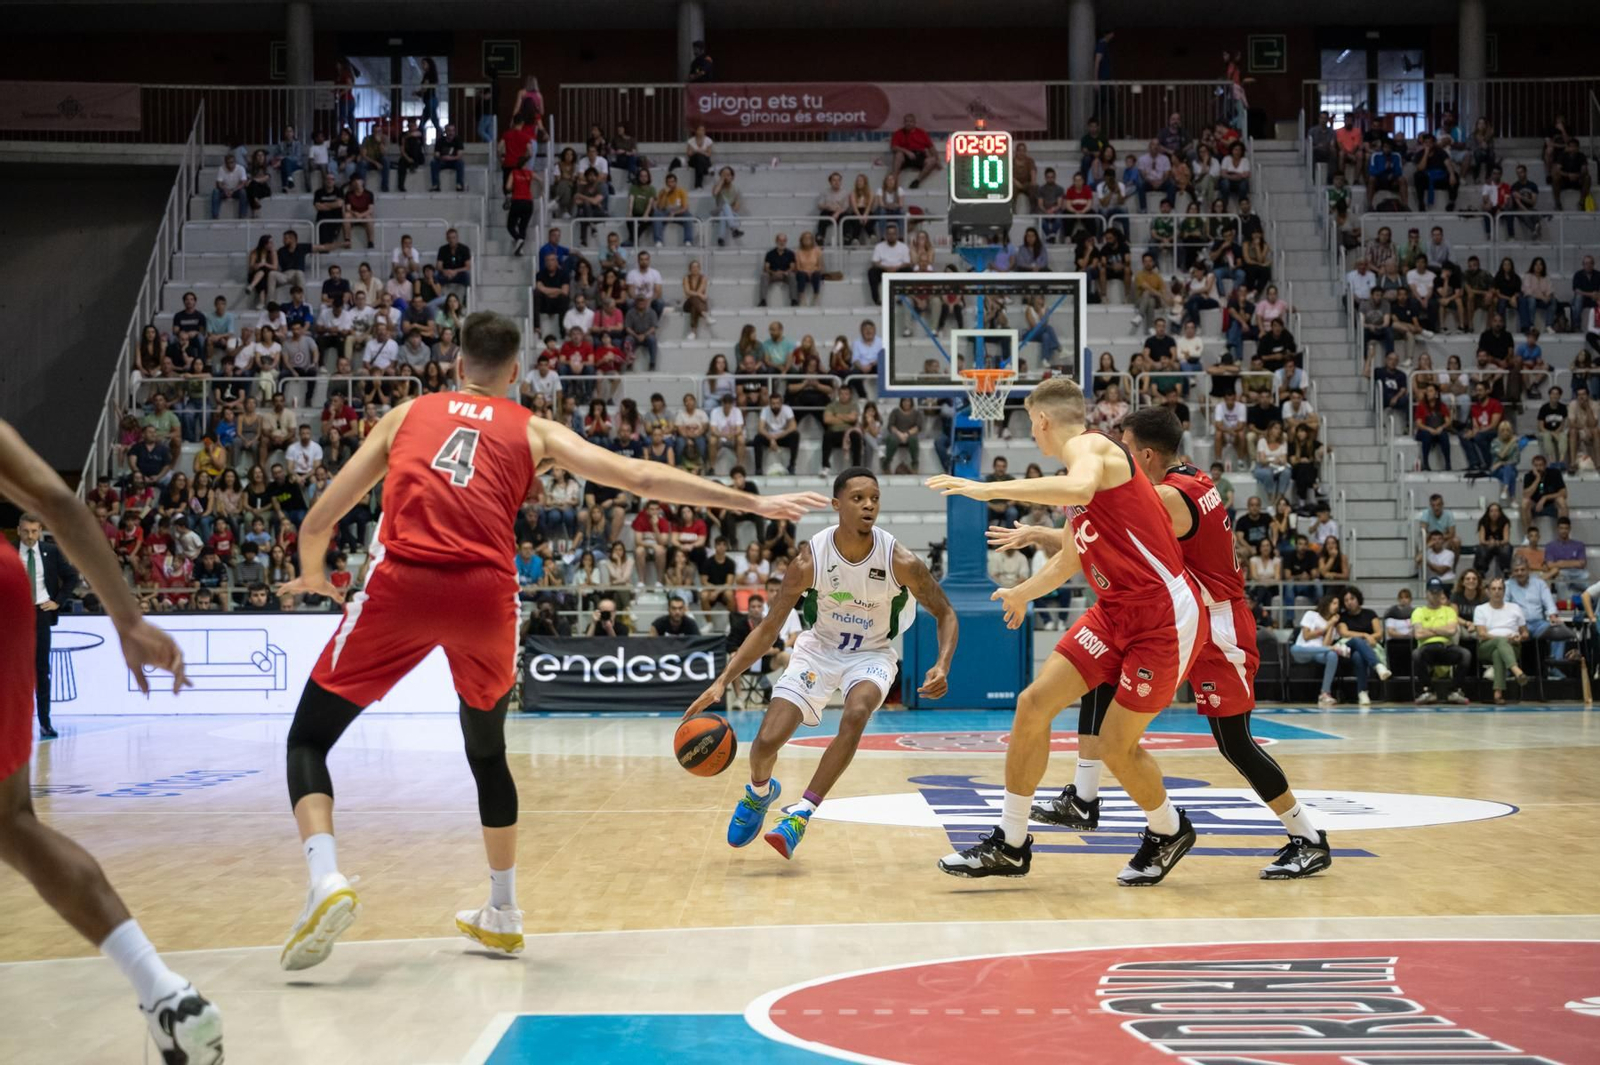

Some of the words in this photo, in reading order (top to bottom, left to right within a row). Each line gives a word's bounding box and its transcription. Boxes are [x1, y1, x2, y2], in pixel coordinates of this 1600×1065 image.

[698, 92, 761, 114] girona
[768, 94, 797, 108] ets
[803, 94, 822, 108] tu
[740, 111, 790, 126] girona
[795, 110, 812, 122] és
[816, 111, 866, 125] esport
[955, 135, 1007, 154] 02:05
[972, 155, 1003, 189] 10
[447, 399, 494, 421] VILA
[430, 426, 481, 488] 4
[1073, 625, 1109, 660] YOSOY
[529, 646, 716, 683] endesa
